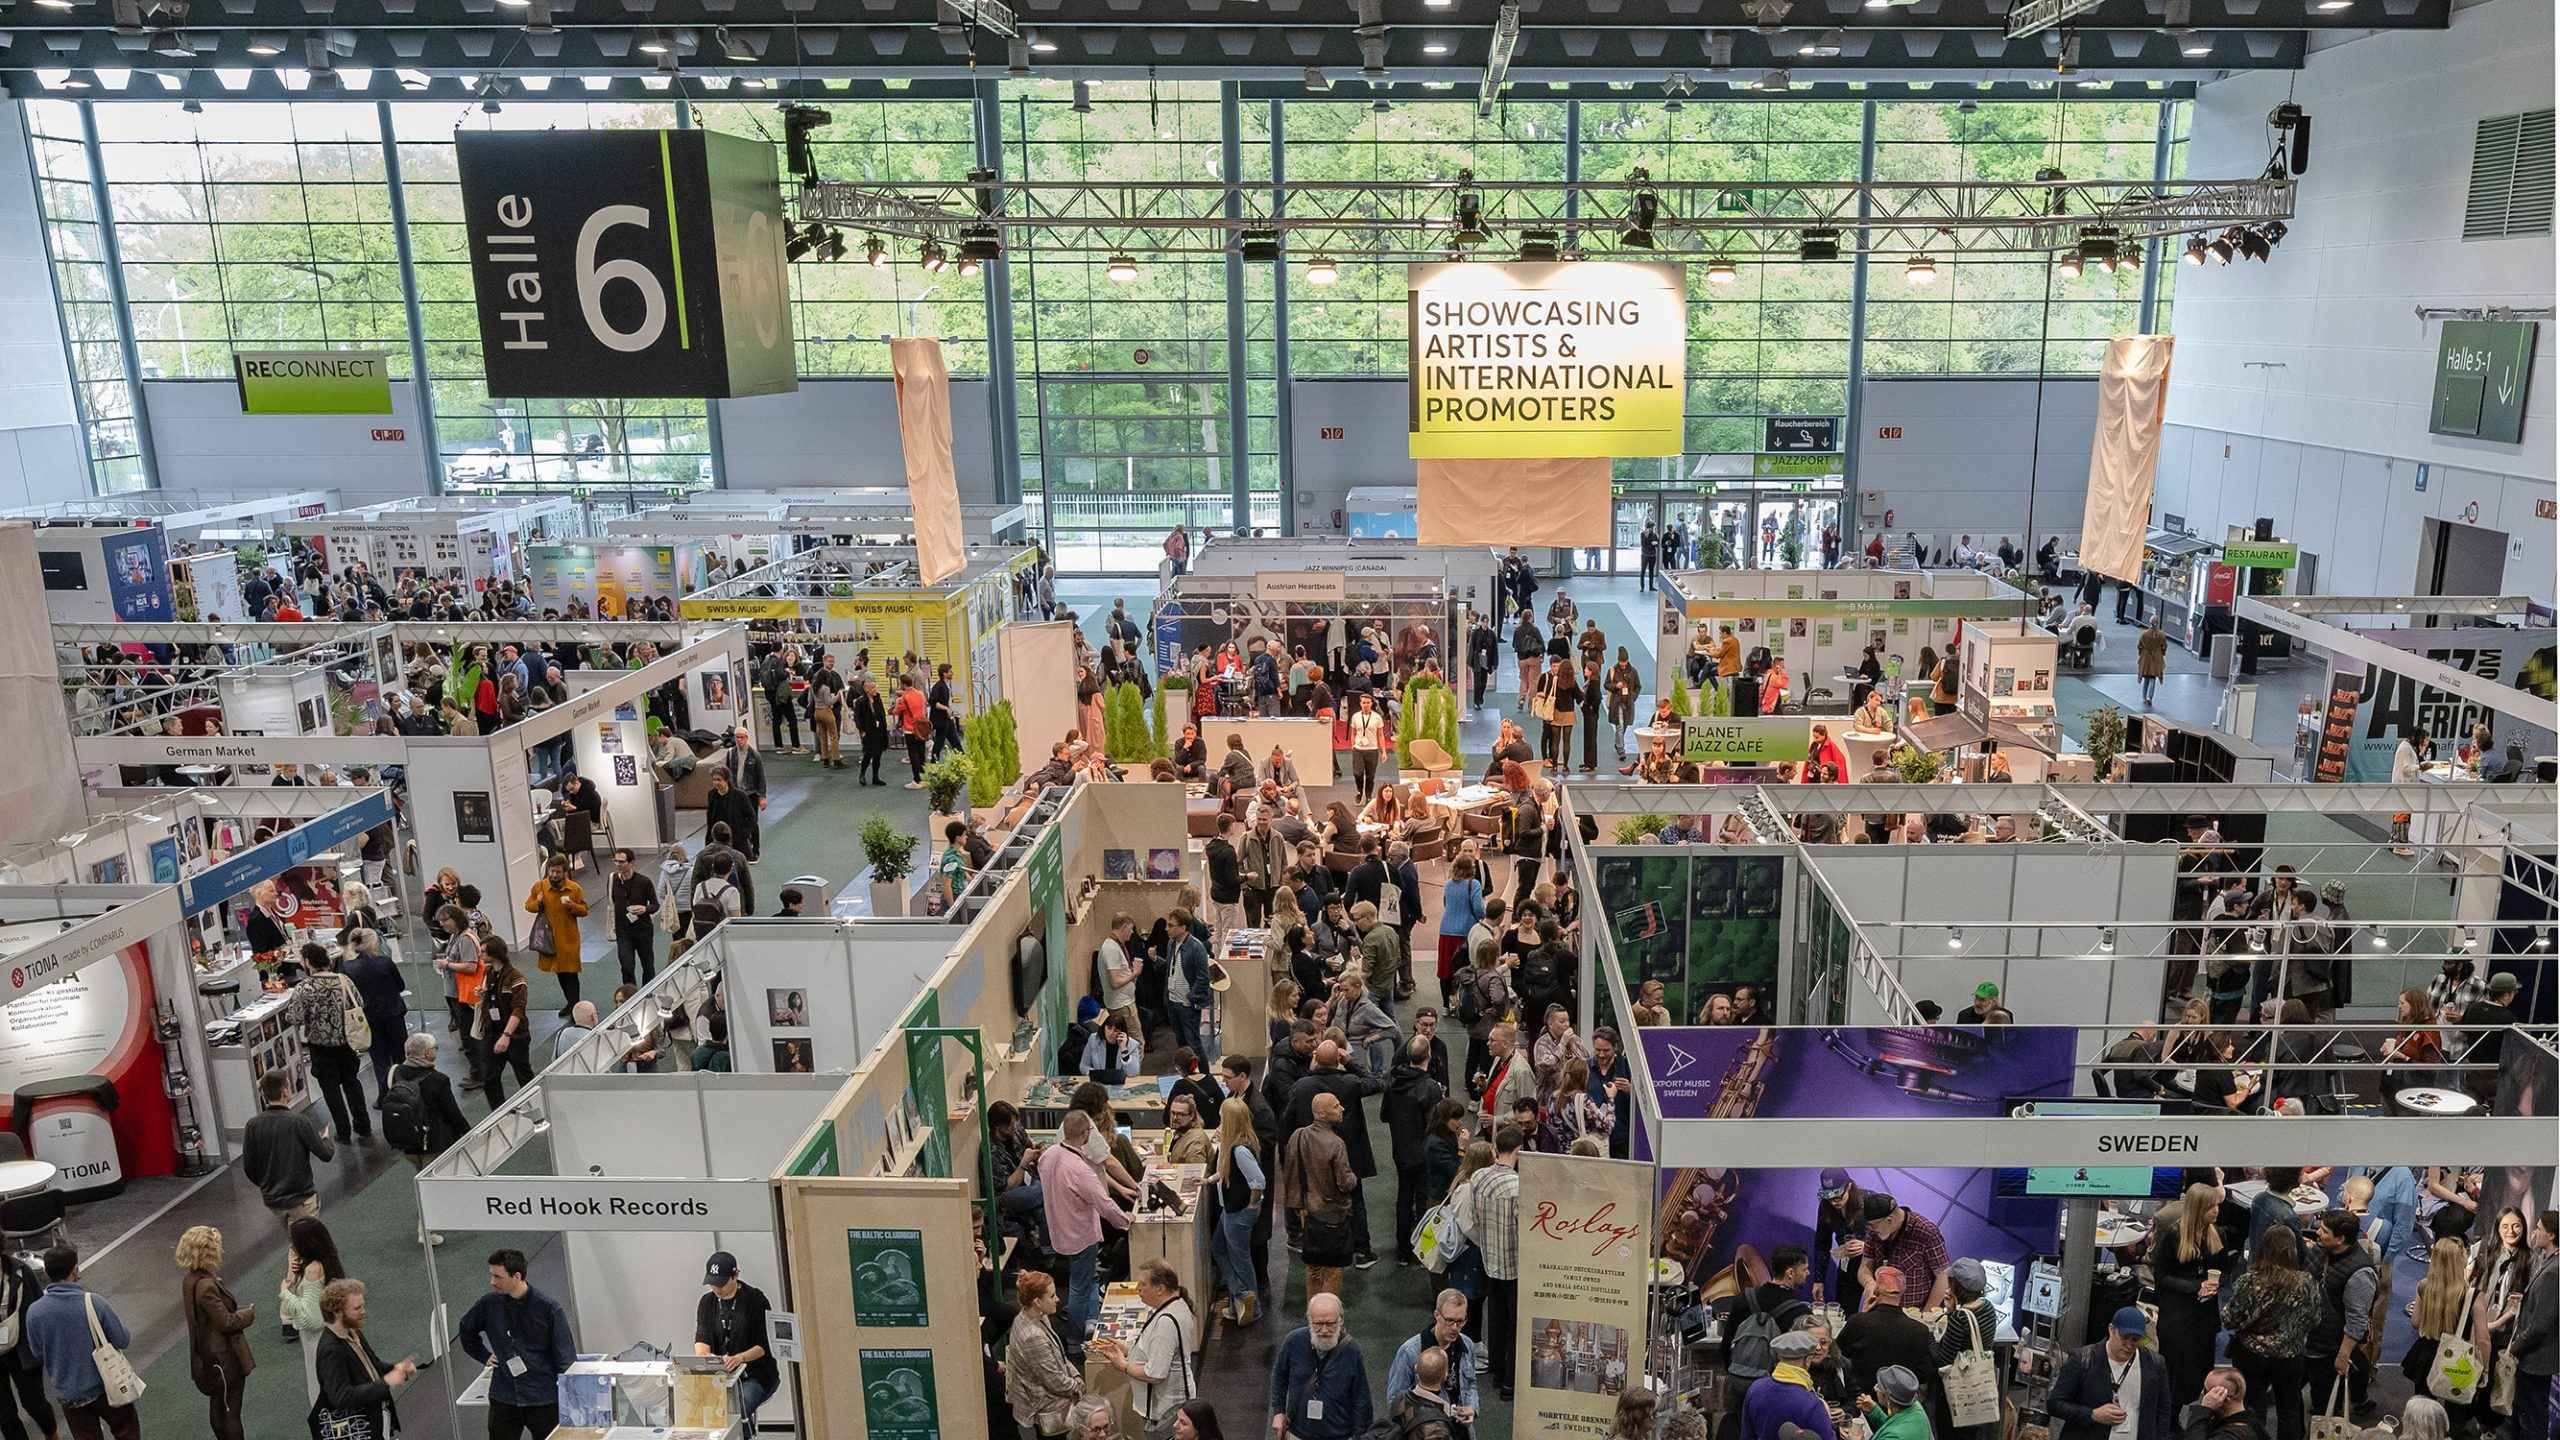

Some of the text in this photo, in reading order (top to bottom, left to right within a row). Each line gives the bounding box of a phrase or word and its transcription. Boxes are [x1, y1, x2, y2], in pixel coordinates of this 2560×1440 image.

[487, 194, 549, 350] Halle
[575, 204, 667, 352] 6
[1425, 300, 1640, 327] SHOWCASING
[1425, 333, 1577, 359] ARTISTS &
[245, 360, 376, 378] RECONNECT
[2446, 348, 2493, 373] Halle 5-1
[1426, 364, 1673, 391] INTERNATIONAL
[1426, 396, 1616, 423] PROMOTERS
[1774, 419, 1830, 428] Raucherbereich
[1772, 455, 1831, 466] JAZZPORT
[2227, 549, 2289, 560] RESTAURANT
[1355, 564, 1387, 572] (CANADA)
[1266, 582, 1336, 591] Austrian Heartbeats
[706, 605, 767, 613] SWISS MUSIC
[854, 605, 914, 613] SWISS MUSIC
[1688, 726, 1744, 738] PLANET
[166, 744, 256, 757] German Market
[1687, 737, 1764, 752] JAZZ CAFÉ
[25, 953, 59, 980] TiONA
[1663, 1089, 1698, 1097] SWEDEN
[2097, 1135, 2199, 1153] SWEDEN
[61, 1160, 111, 1180] TiONA
[486, 1197, 709, 1216] Red Hook Records
[1529, 1201, 1641, 1257] Roslags
